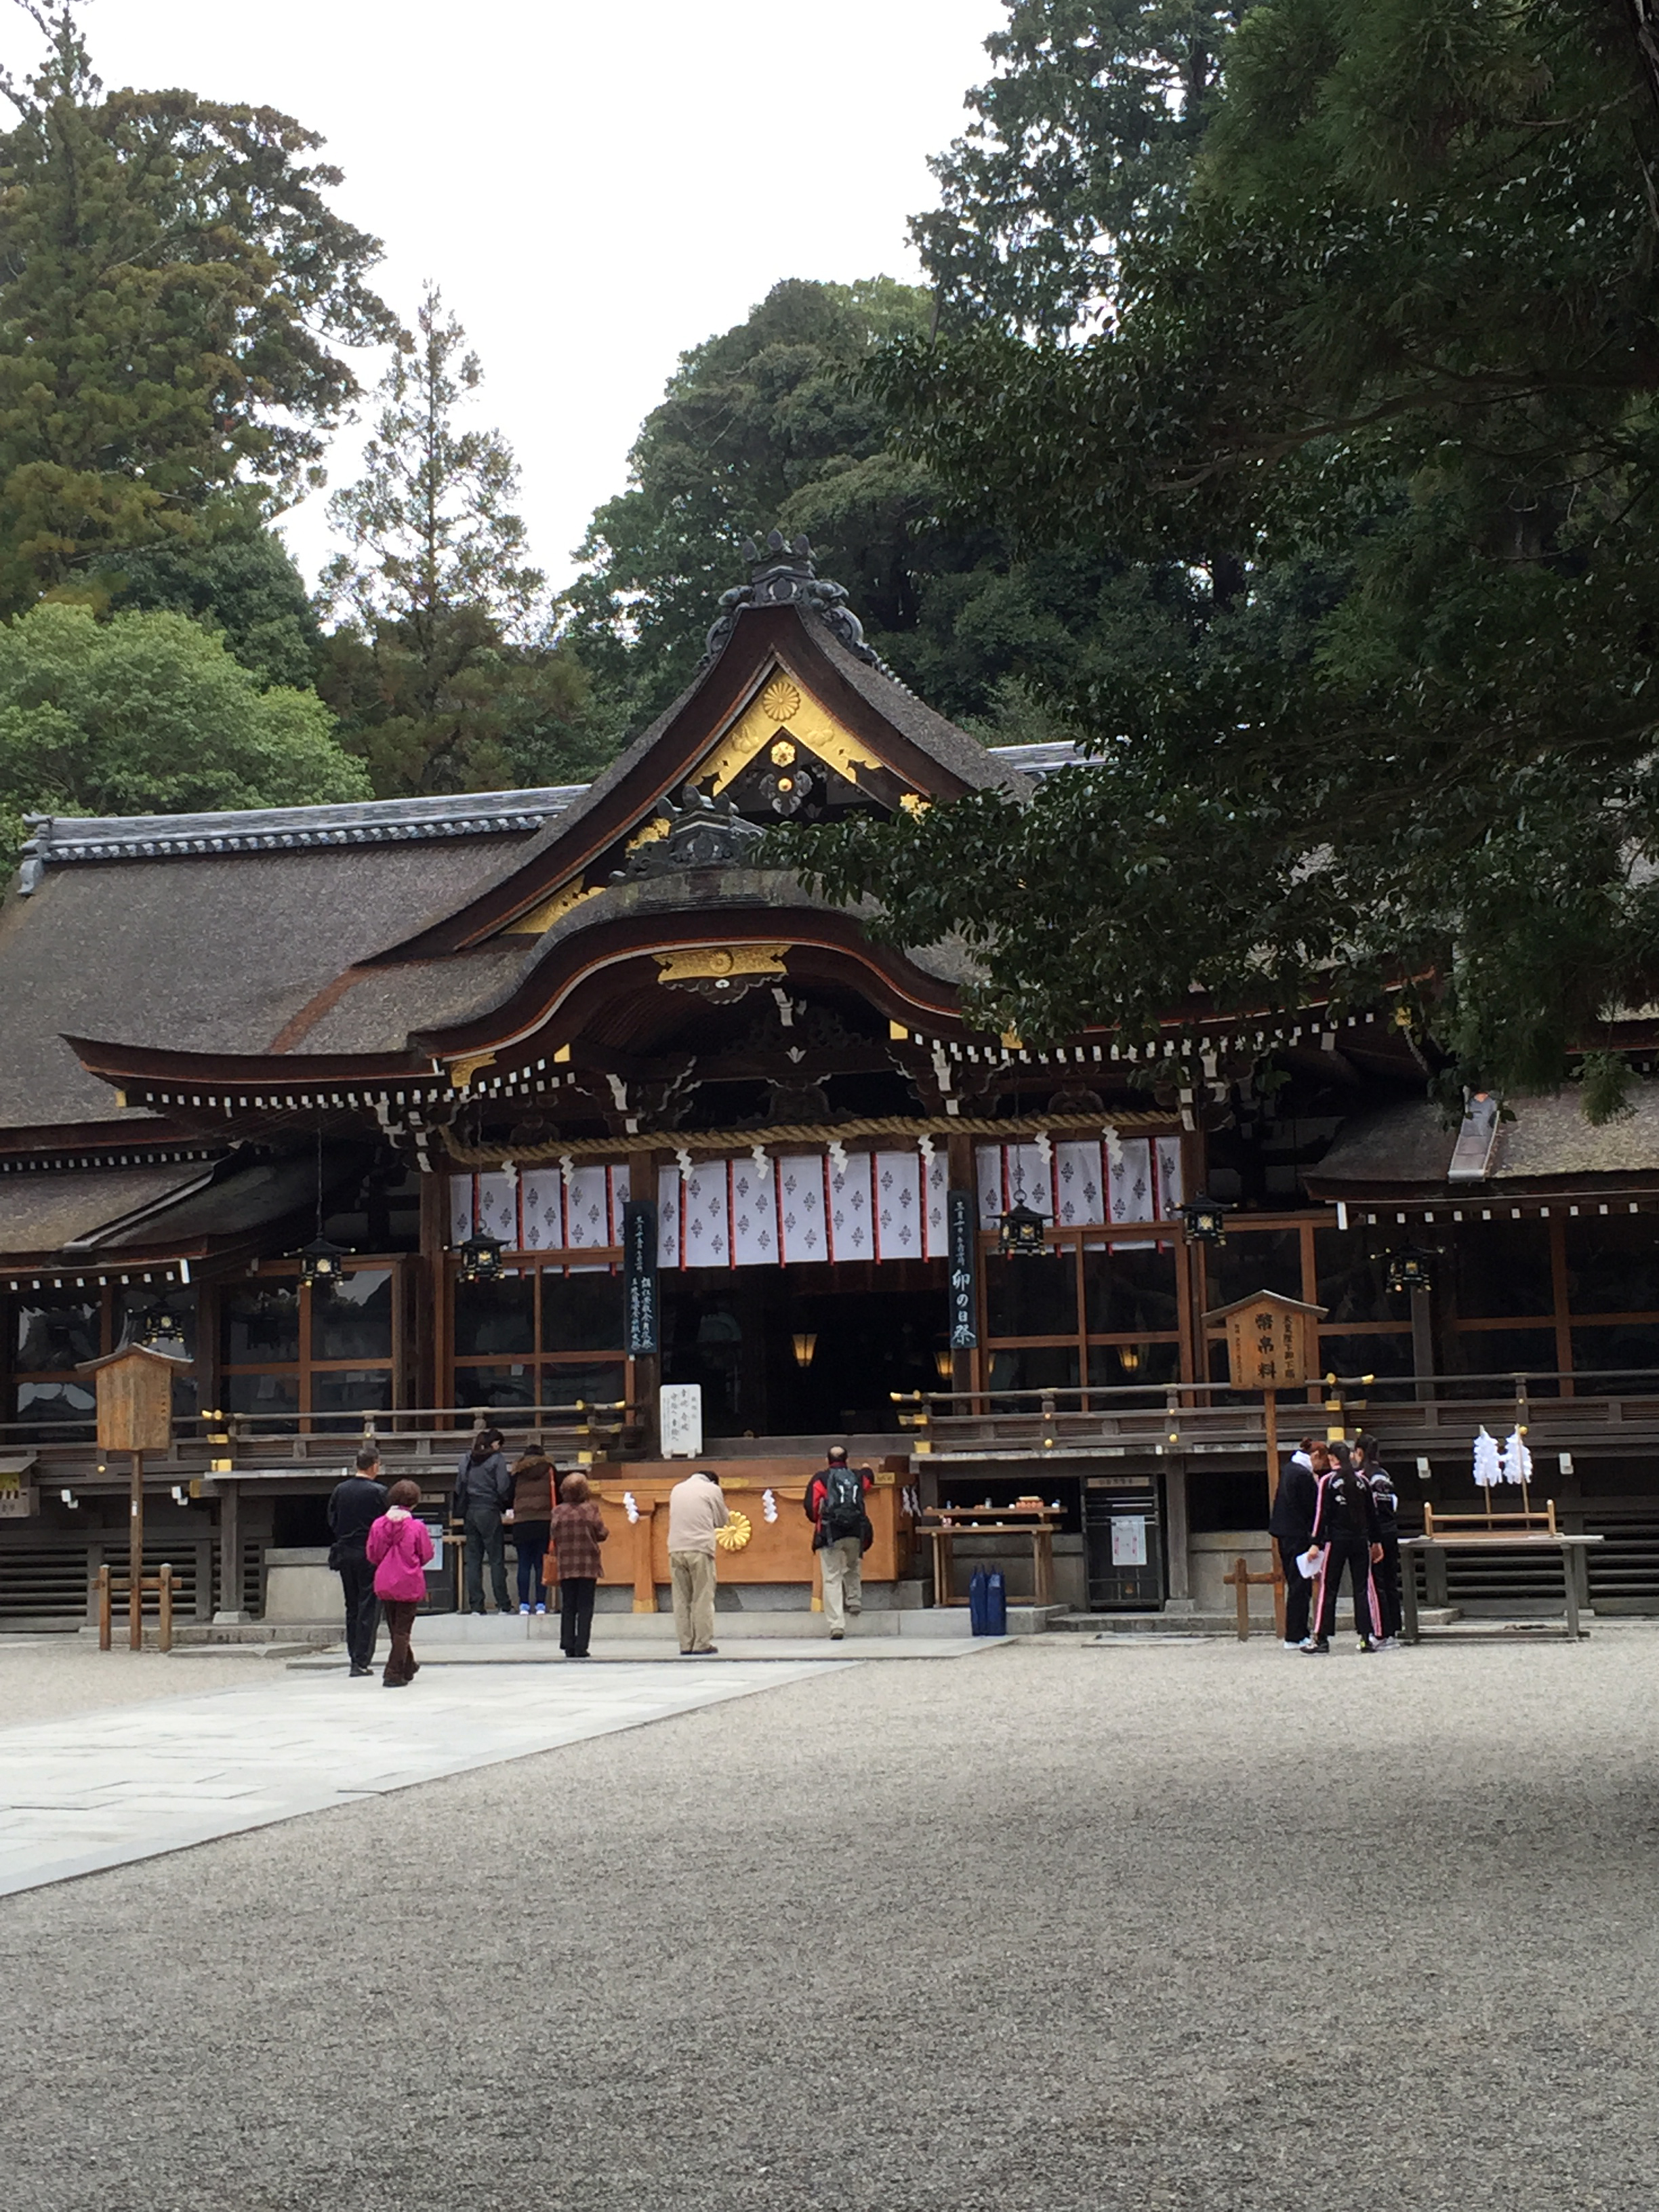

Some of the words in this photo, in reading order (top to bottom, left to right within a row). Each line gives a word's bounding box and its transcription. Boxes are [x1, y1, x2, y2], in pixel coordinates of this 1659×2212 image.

[951, 1269, 976, 1345] 卯の日祭
[1255, 1312, 1277, 1380] 幣帛料
